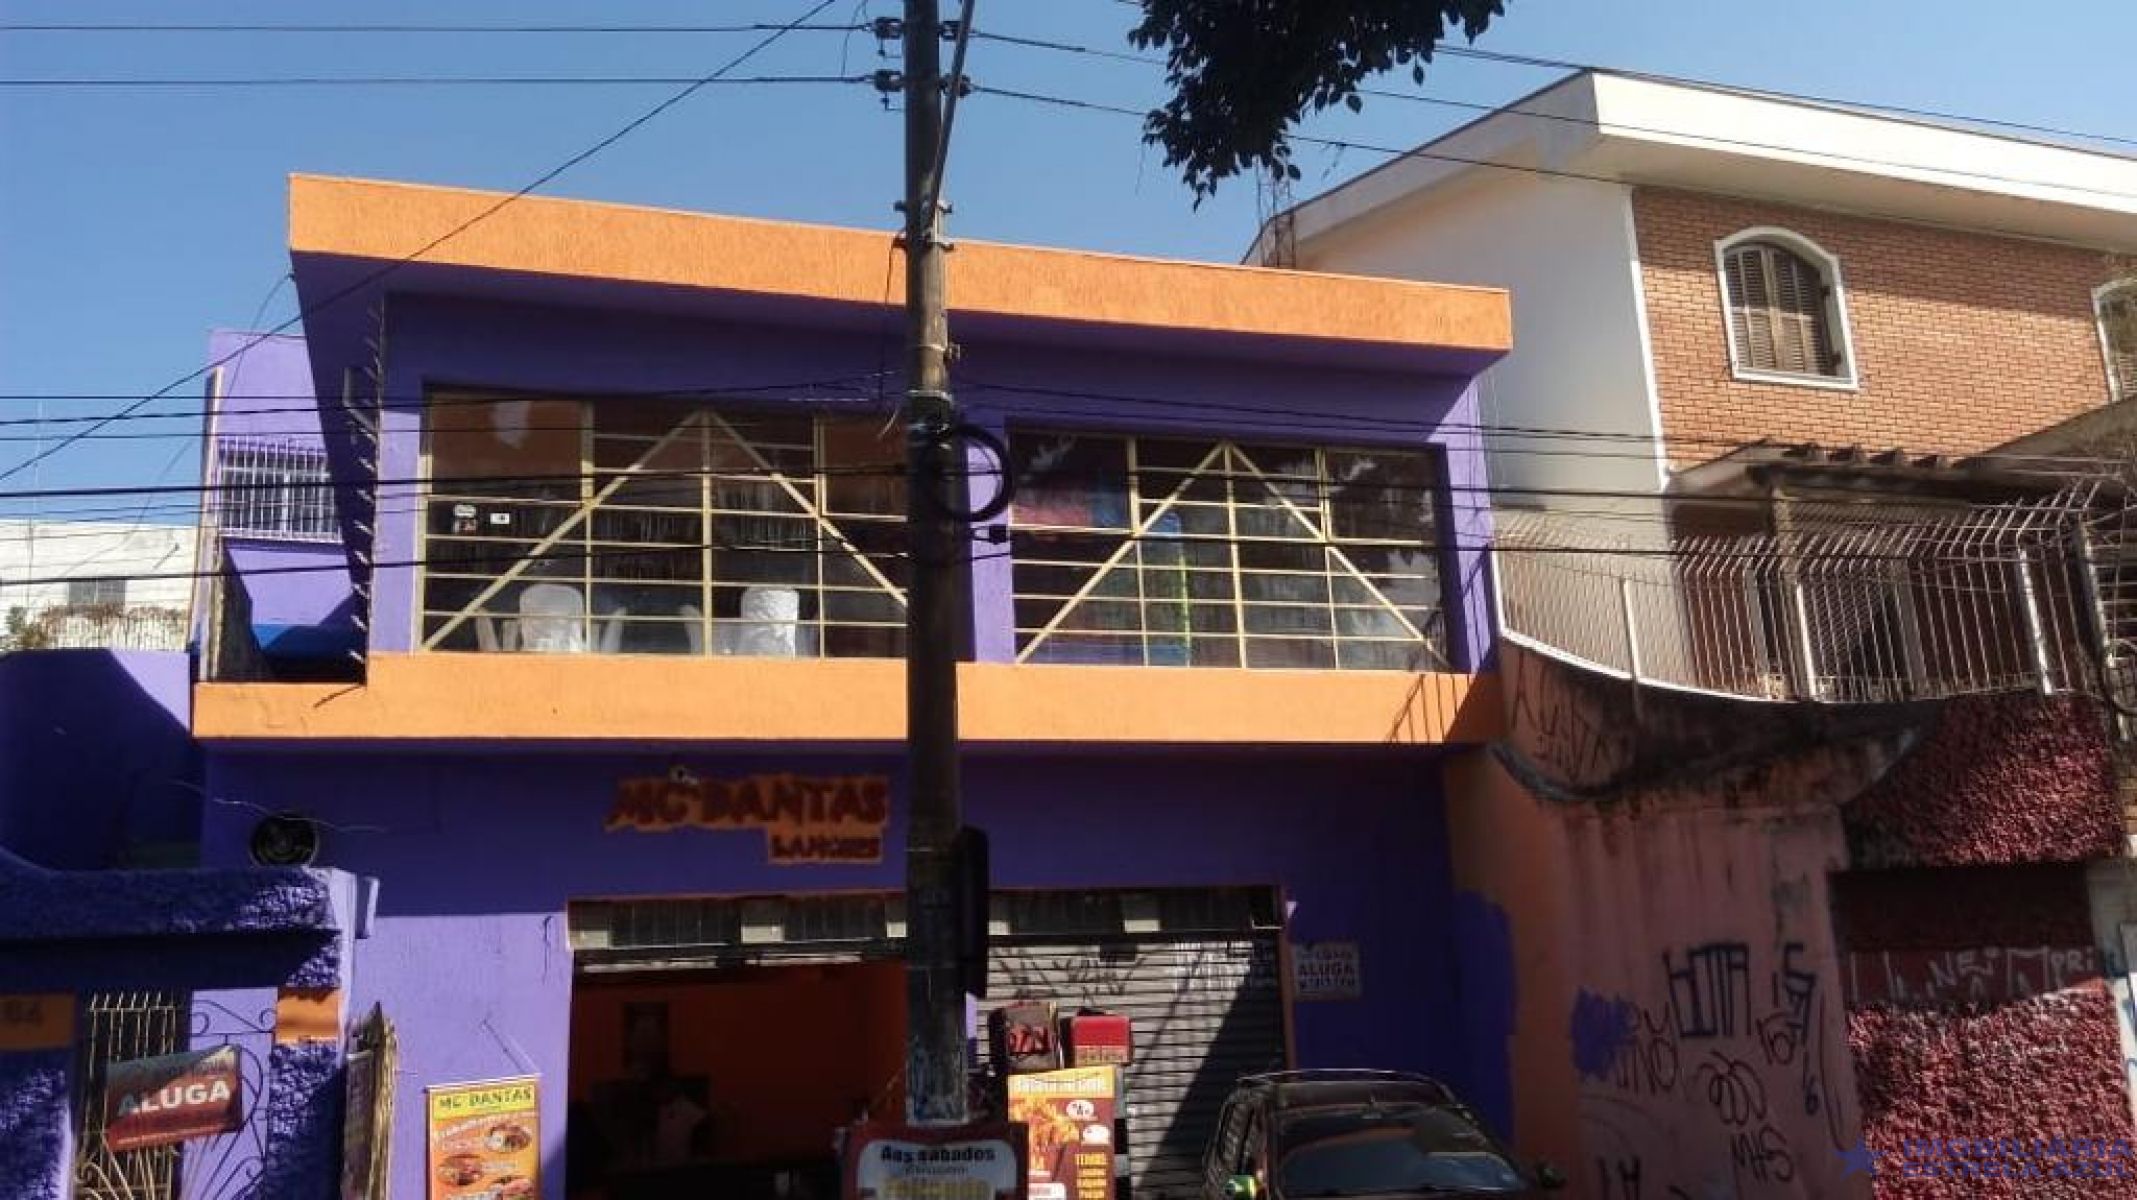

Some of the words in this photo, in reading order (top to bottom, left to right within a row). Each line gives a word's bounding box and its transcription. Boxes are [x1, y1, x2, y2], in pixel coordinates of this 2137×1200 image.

[701, 777, 887, 825] DANTAS
[1298, 962, 1355, 977] ALUGA
[117, 1079, 232, 1118] ALUGA
[468, 1087, 532, 1107] DANTAS
